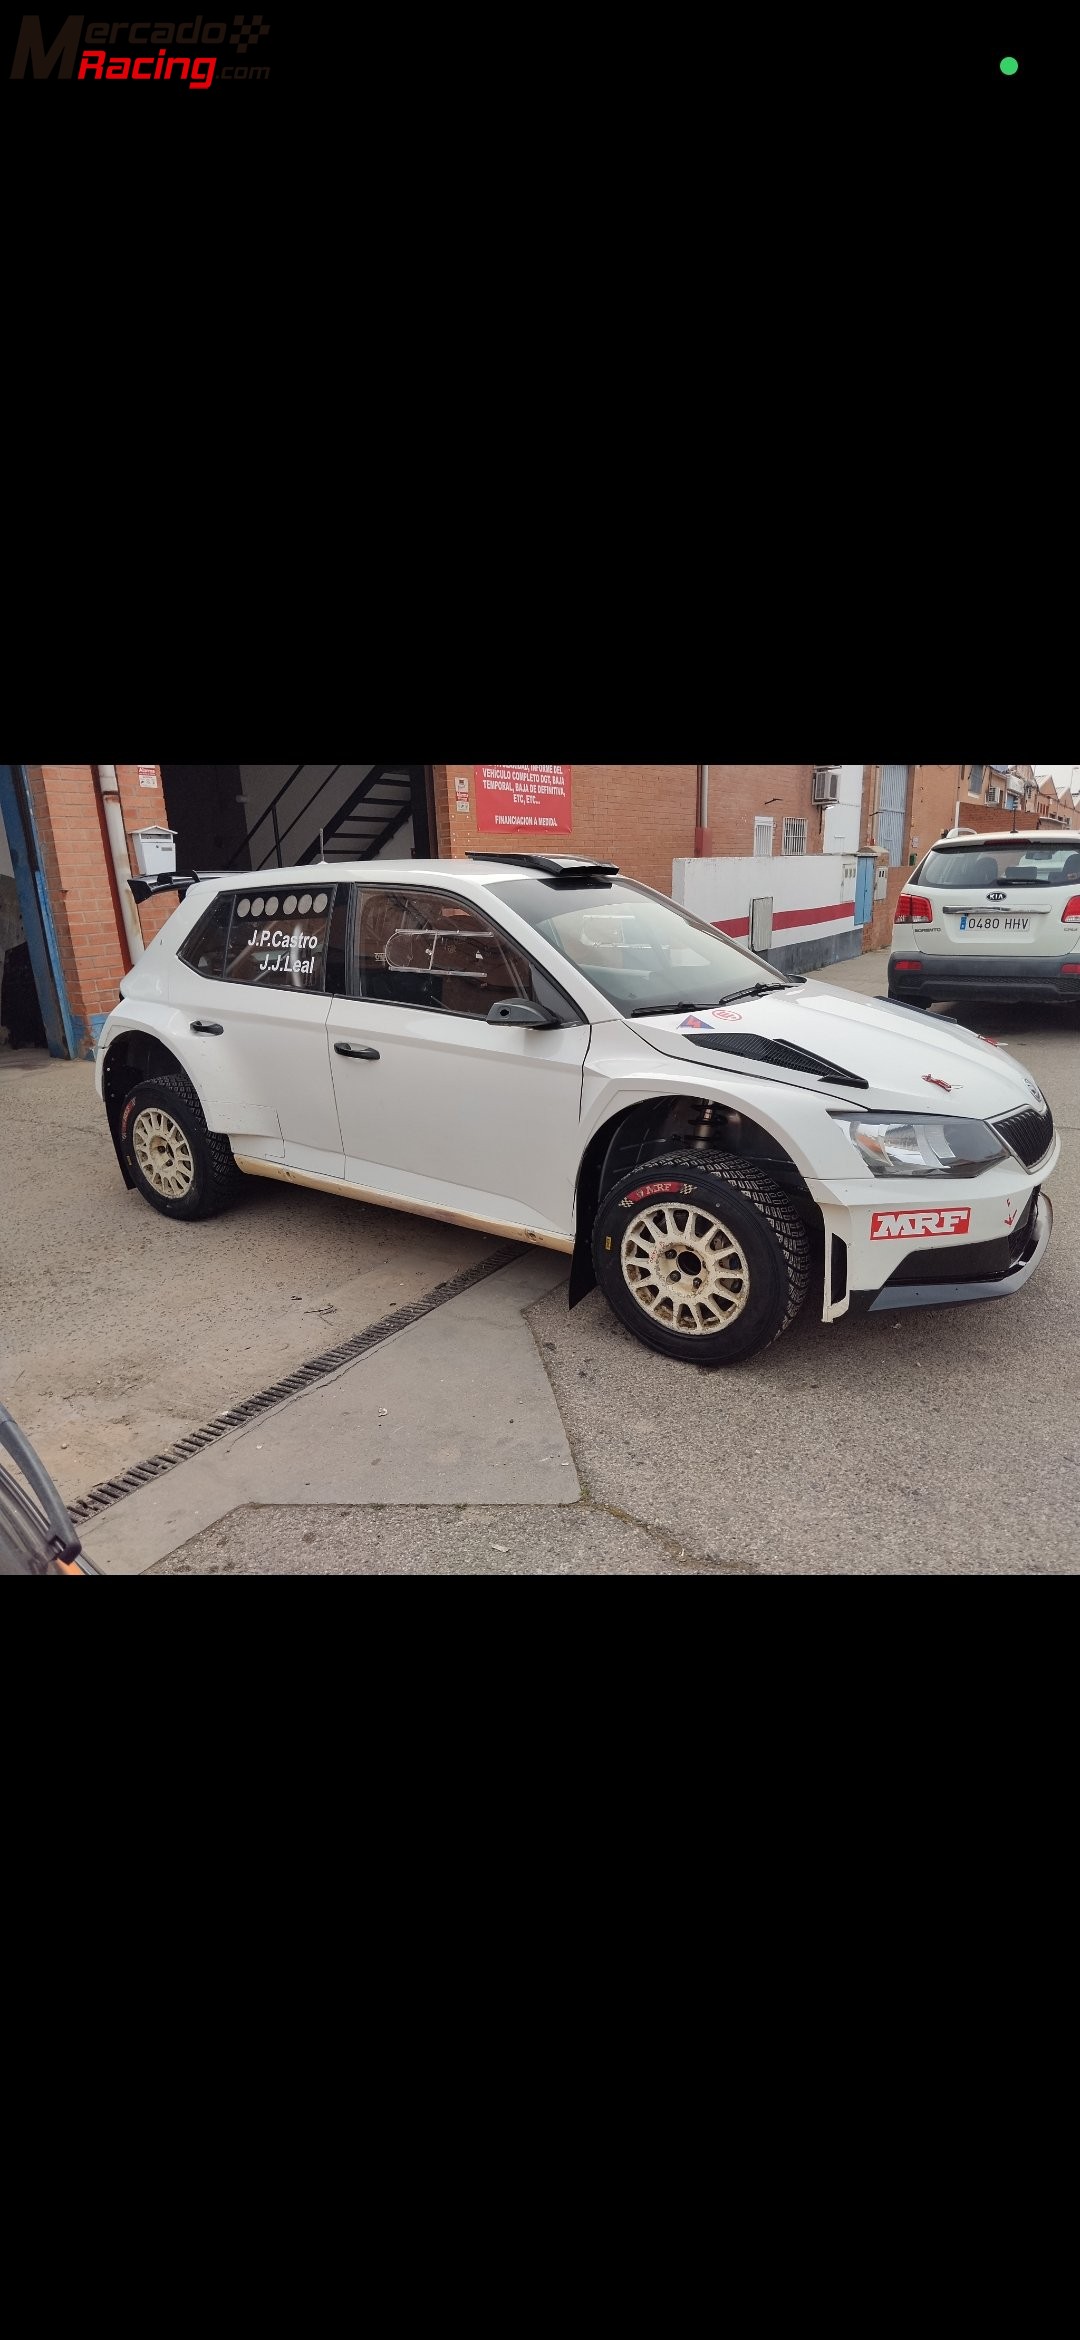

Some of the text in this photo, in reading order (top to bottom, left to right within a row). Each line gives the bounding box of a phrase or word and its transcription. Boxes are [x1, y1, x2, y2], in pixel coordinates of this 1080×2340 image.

[512, 772, 540, 783] COMPLETO
[552, 776, 565, 786] BAJA
[482, 780, 515, 793] TEMPORAL,
[515, 783, 529, 793] BAJA
[529, 784, 537, 794] DE
[513, 794, 526, 805] ETC,
[968, 918, 1029, 930] 0480 HHV
[247, 929, 318, 949] J.P.Castro
[259, 954, 315, 974] J.J.Leal
[646, 1183, 672, 1195] MRF
[873, 1210, 968, 1237] MRF
